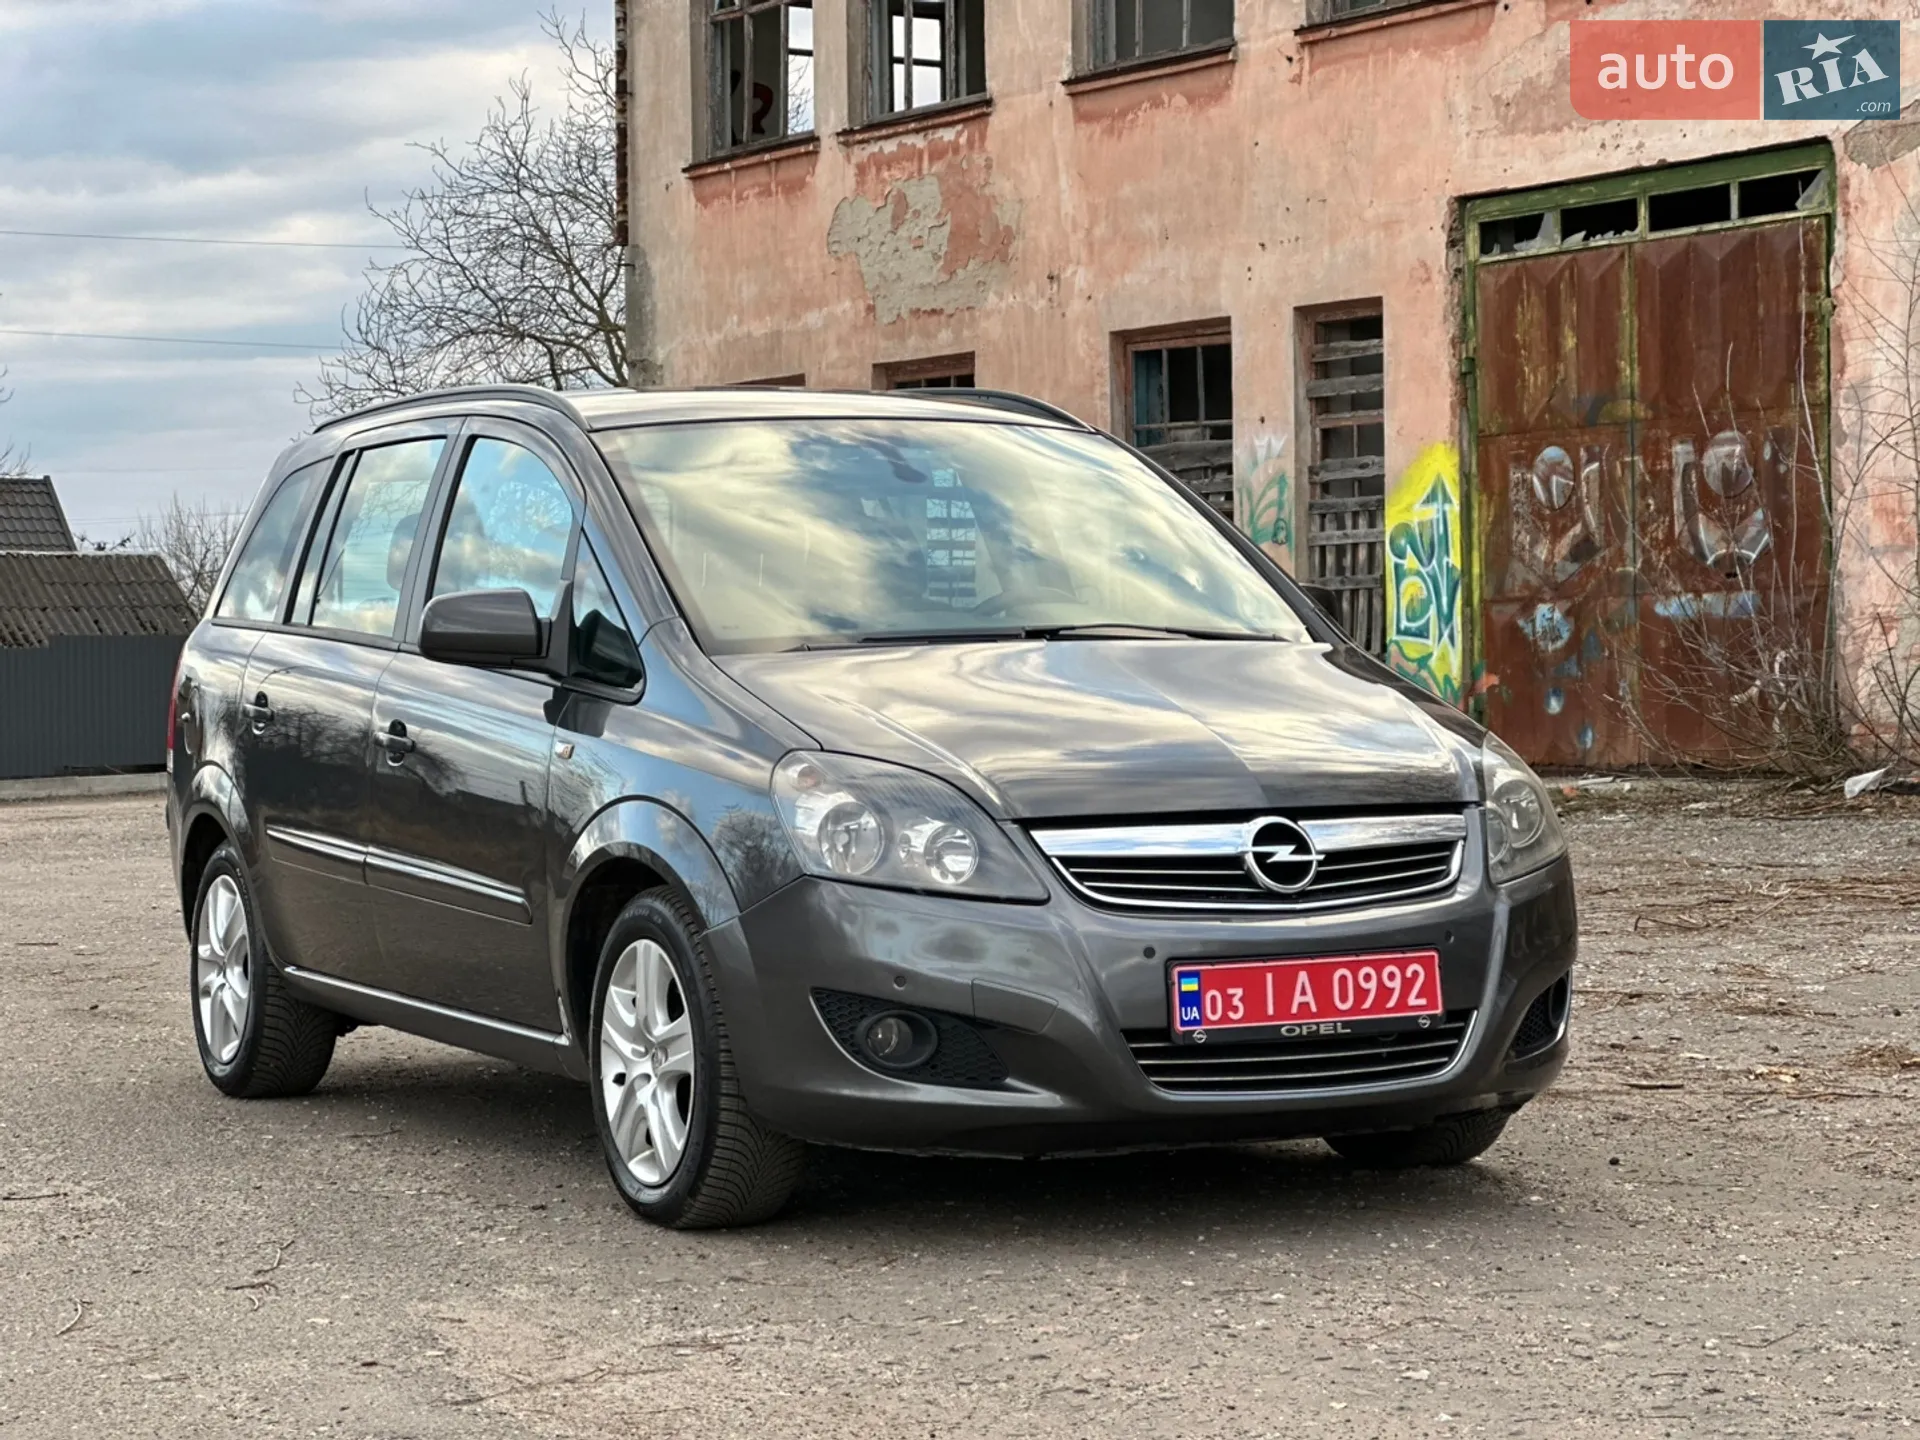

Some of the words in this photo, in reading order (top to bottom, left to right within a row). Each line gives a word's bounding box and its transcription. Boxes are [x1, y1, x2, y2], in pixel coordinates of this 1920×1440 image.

[1205, 988, 1244, 1021] 03
[1332, 963, 1427, 1011] 0992
[1182, 1006, 1200, 1021] UA
[1280, 1023, 1352, 1037] OPEL
